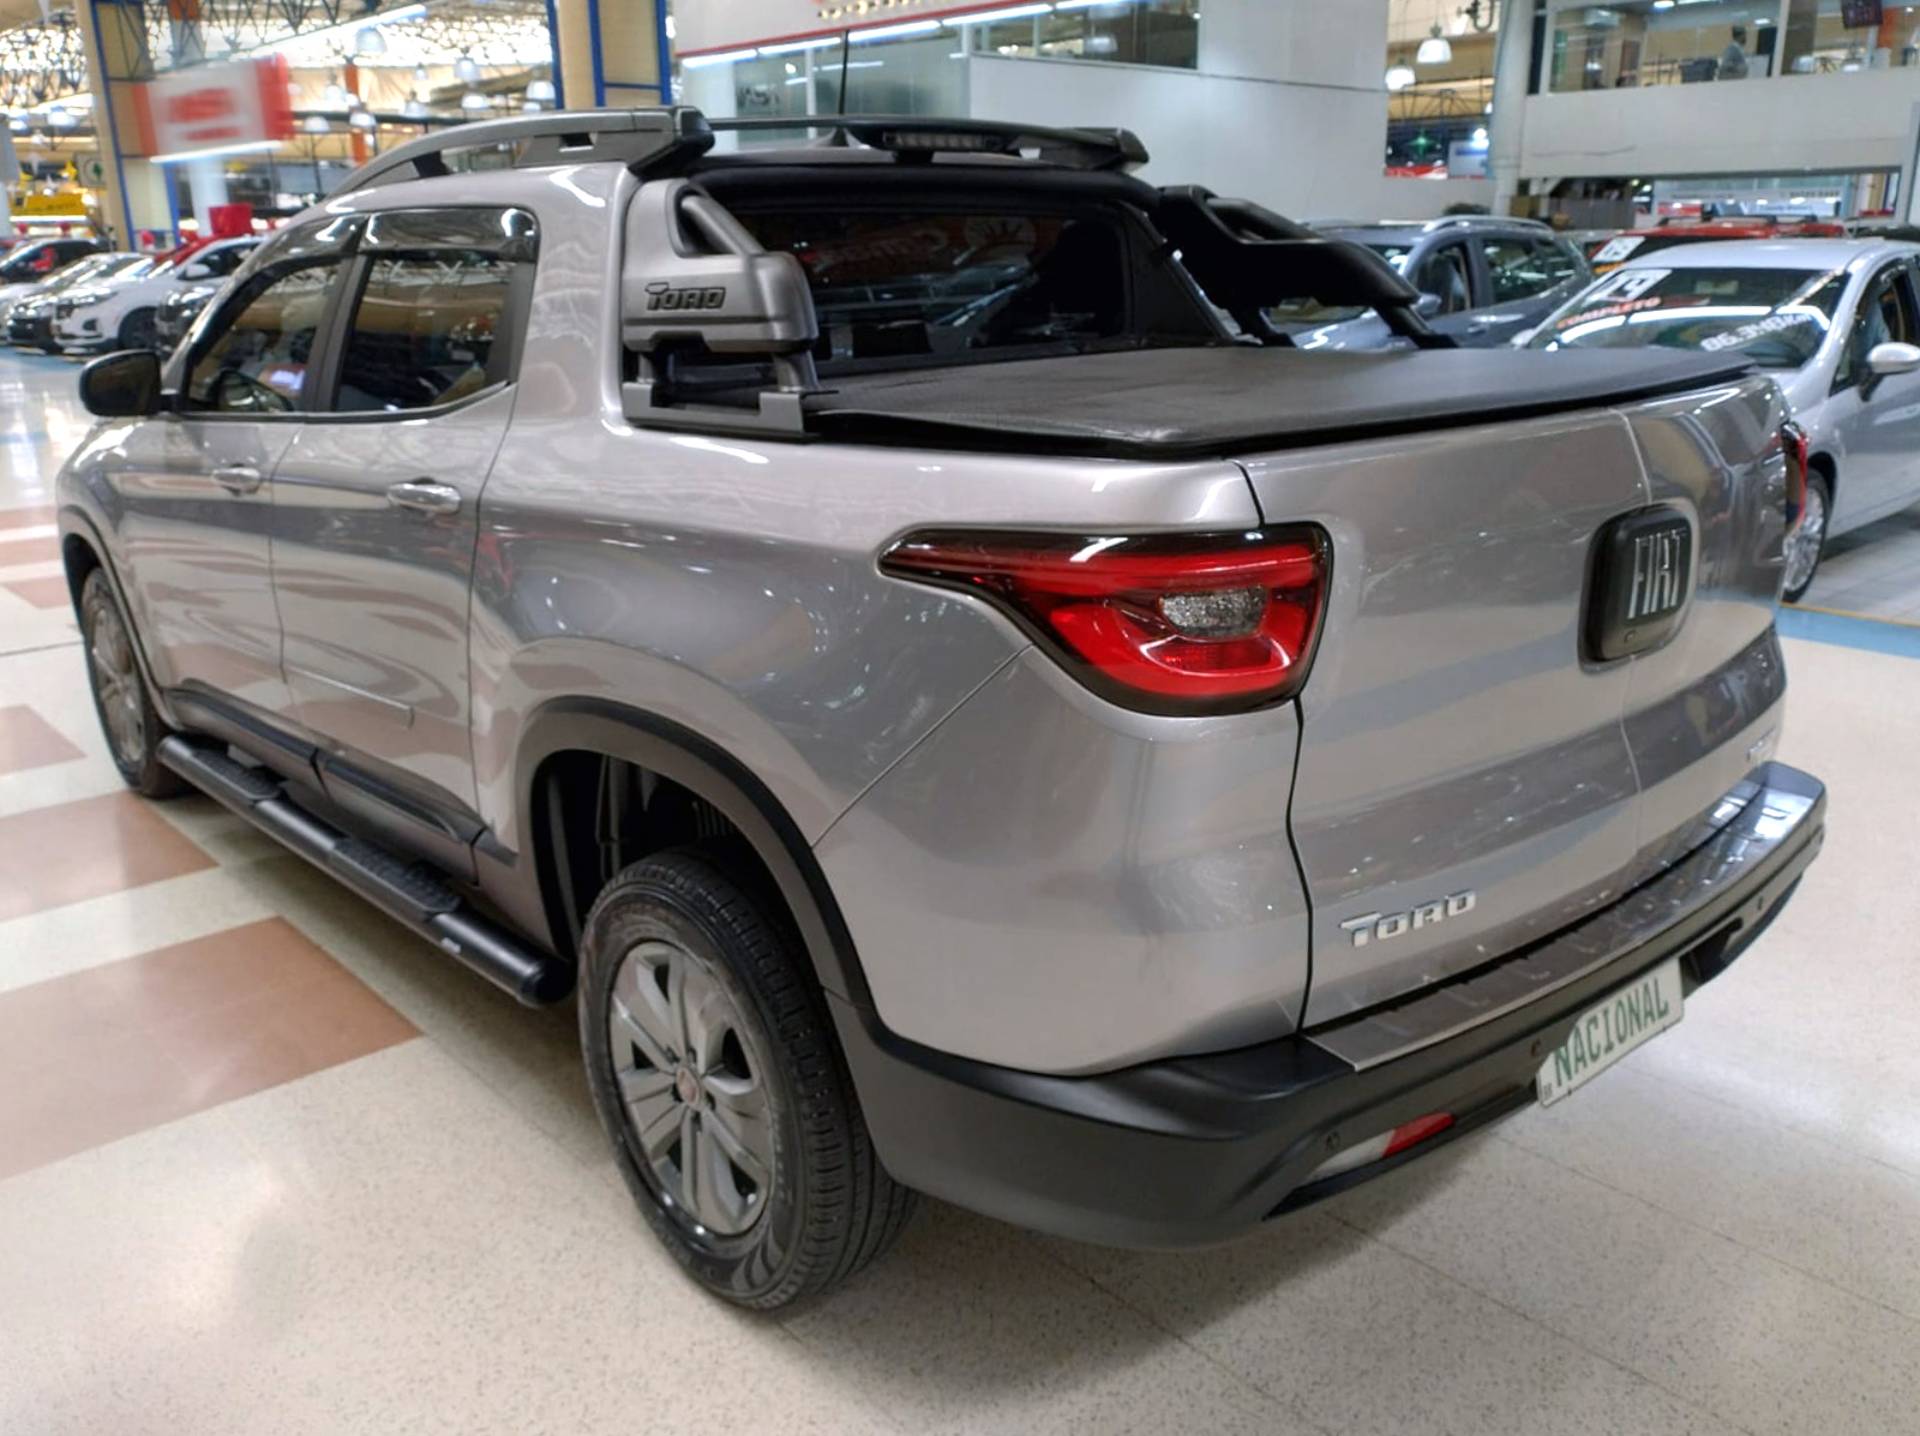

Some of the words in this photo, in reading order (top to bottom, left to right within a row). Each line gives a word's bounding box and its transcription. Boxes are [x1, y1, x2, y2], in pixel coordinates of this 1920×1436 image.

[644, 282, 726, 311] TORO
[1627, 527, 1687, 619] FIAT
[1338, 888, 1477, 948] TORO
[1553, 976, 1670, 1088] NACIONAL
